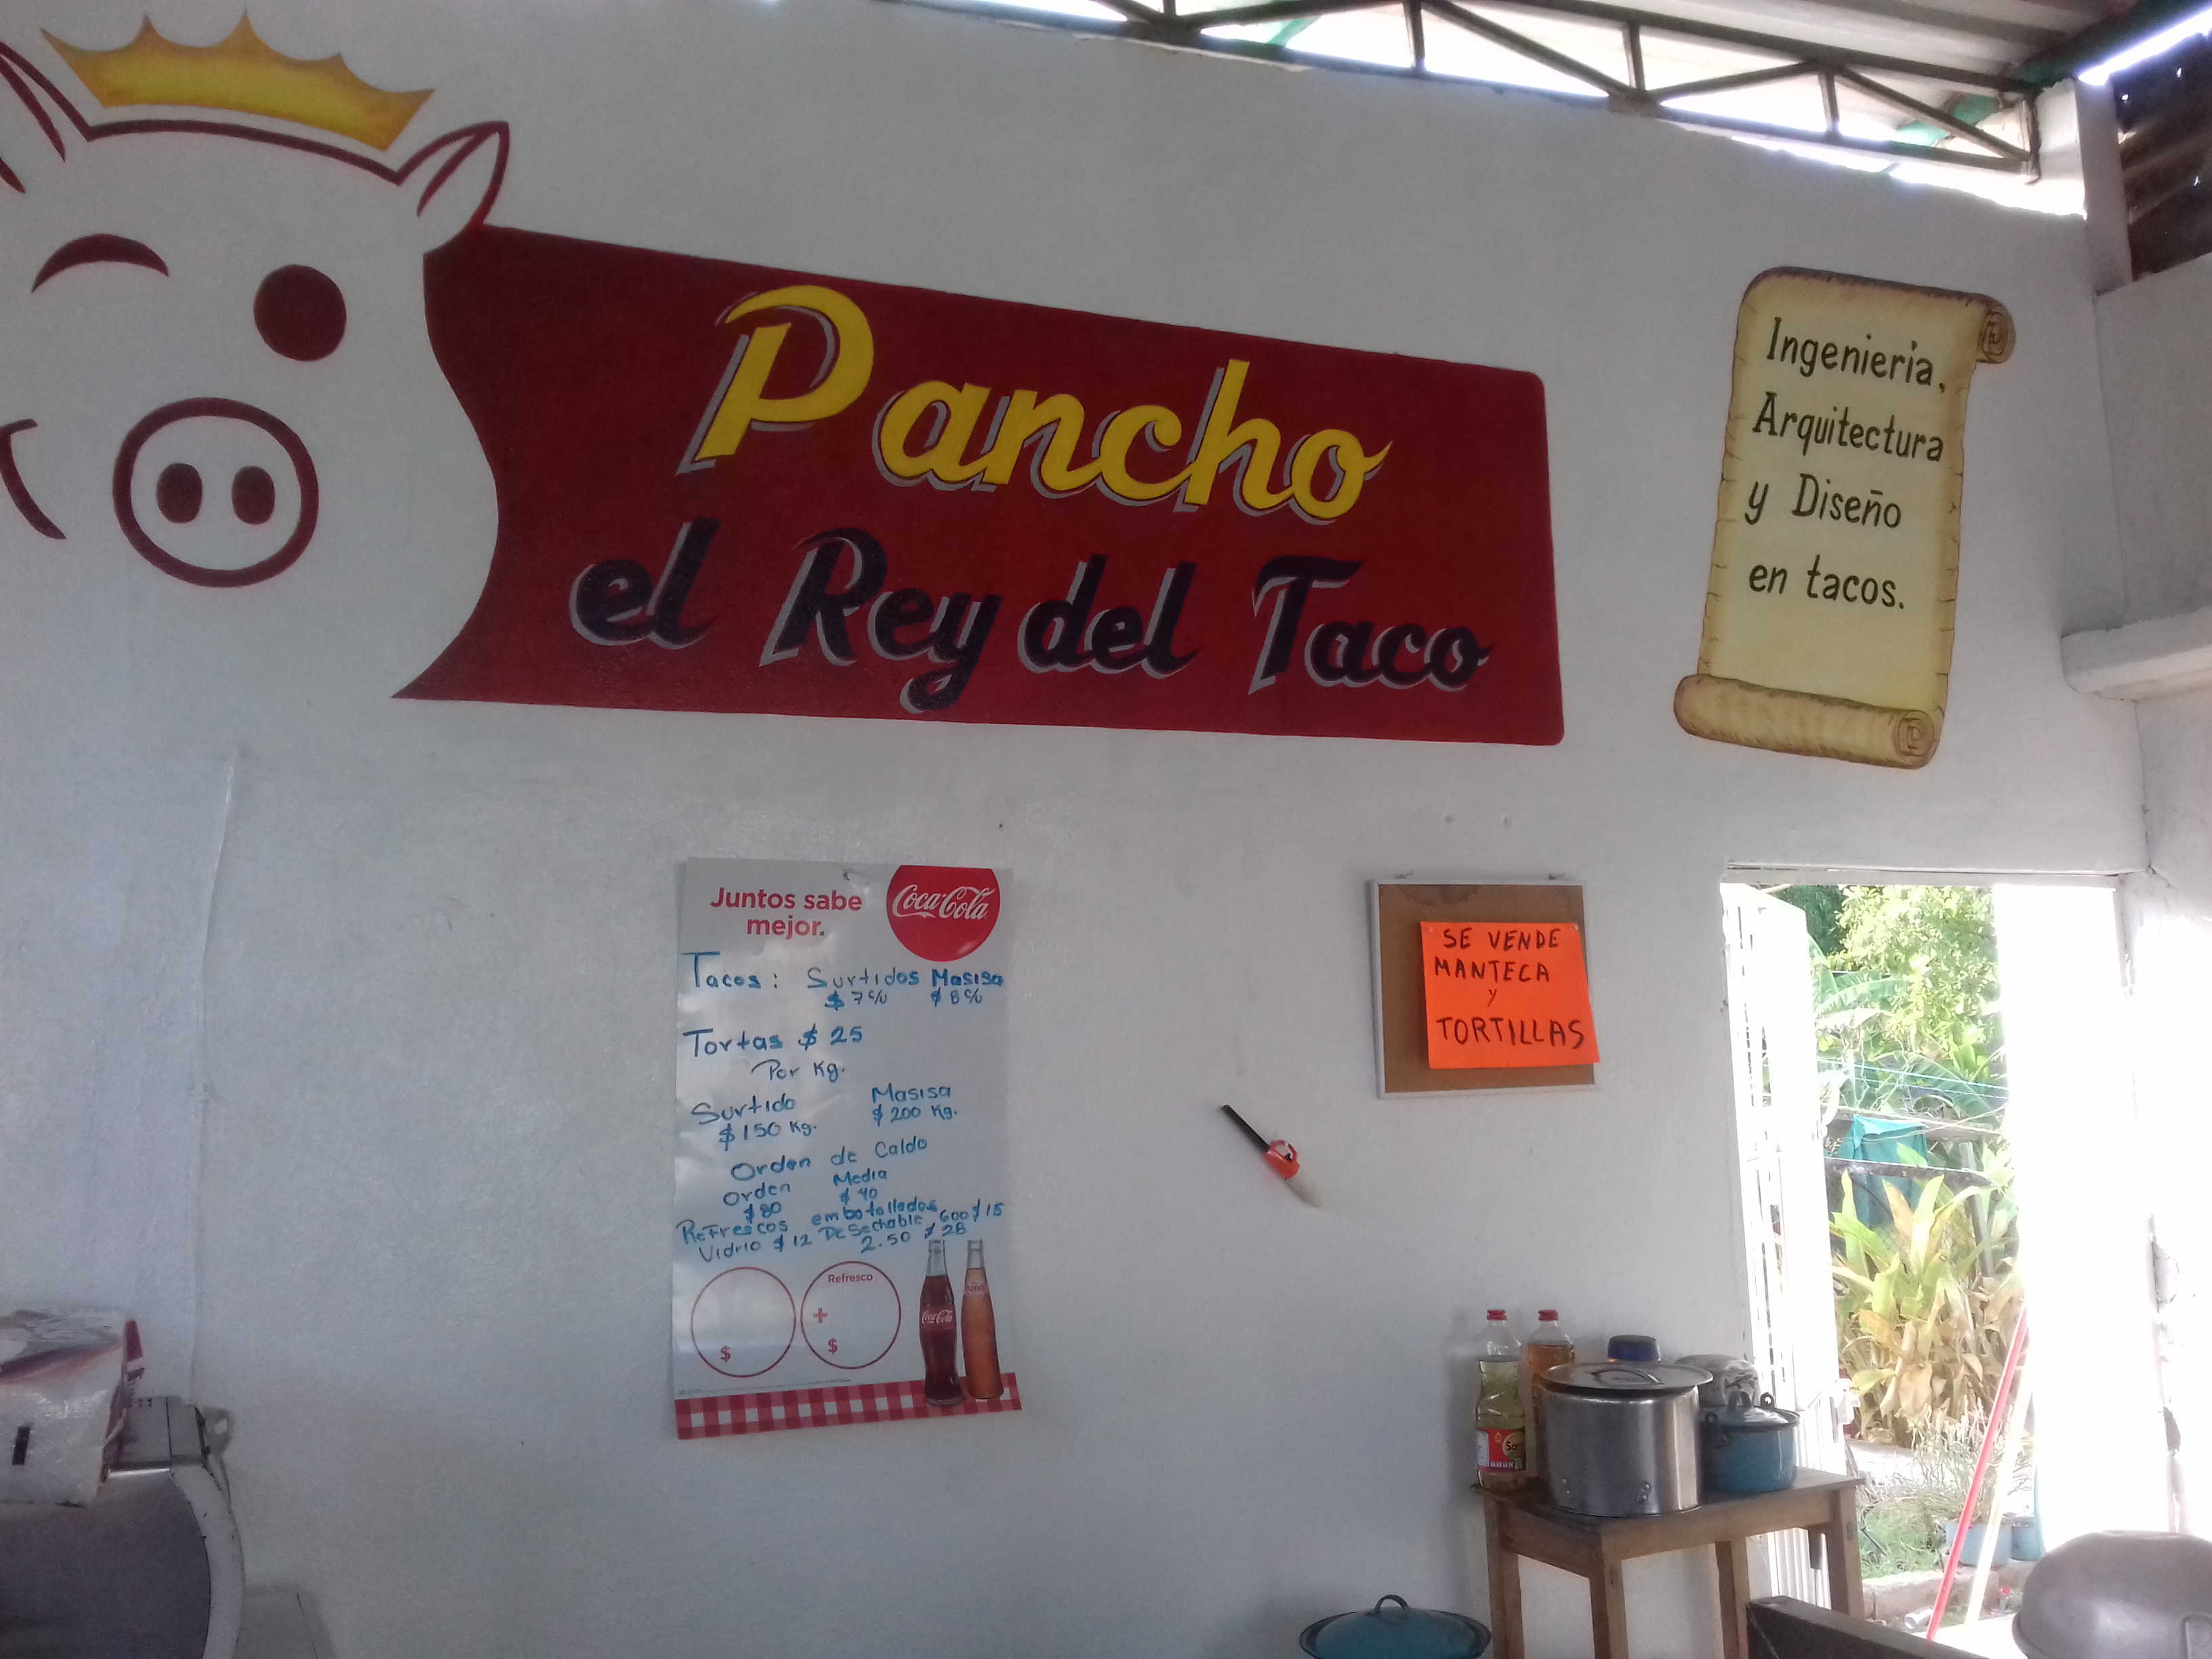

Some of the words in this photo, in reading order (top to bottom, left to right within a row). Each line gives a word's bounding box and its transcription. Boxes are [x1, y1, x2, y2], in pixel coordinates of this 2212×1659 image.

[676, 285, 1393, 525] Pancho
[1752, 391, 1944, 462] Arquitectura
[1744, 481, 1769, 525] y
[1791, 473, 1902, 528] Diseño
[1748, 564, 1788, 595] en
[1807, 554, 1904, 609] tacos.
[569, 516, 718, 649] el
[759, 526, 1003, 713] Rey
[1017, 553, 1200, 679] del
[1248, 555, 1491, 695] Taco
[710, 887, 795, 909] Juntos
[804, 889, 863, 912] sabe
[747, 915, 825, 939] mejor.
[1443, 927, 1472, 949] SE
[1488, 928, 1561, 951] VENDE
[807, 966, 920, 989] Surtidos
[1435, 956, 1550, 983] MANTECA
[682, 1028, 783, 1057] Tortas
[1436, 1017, 1584, 1050] TORTILLAS
[691, 1093, 796, 1125] Surtido
[731, 1155, 811, 1181] Orden
[830, 1146, 857, 1166] de
[875, 1137, 928, 1159] Caldo
[833, 1168, 887, 1187] Media
[699, 1241, 760, 1262] Vidrio
[828, 1273, 873, 1284] Refresco
[720, 1345, 731, 1362] $
[827, 1338, 838, 1354] $
